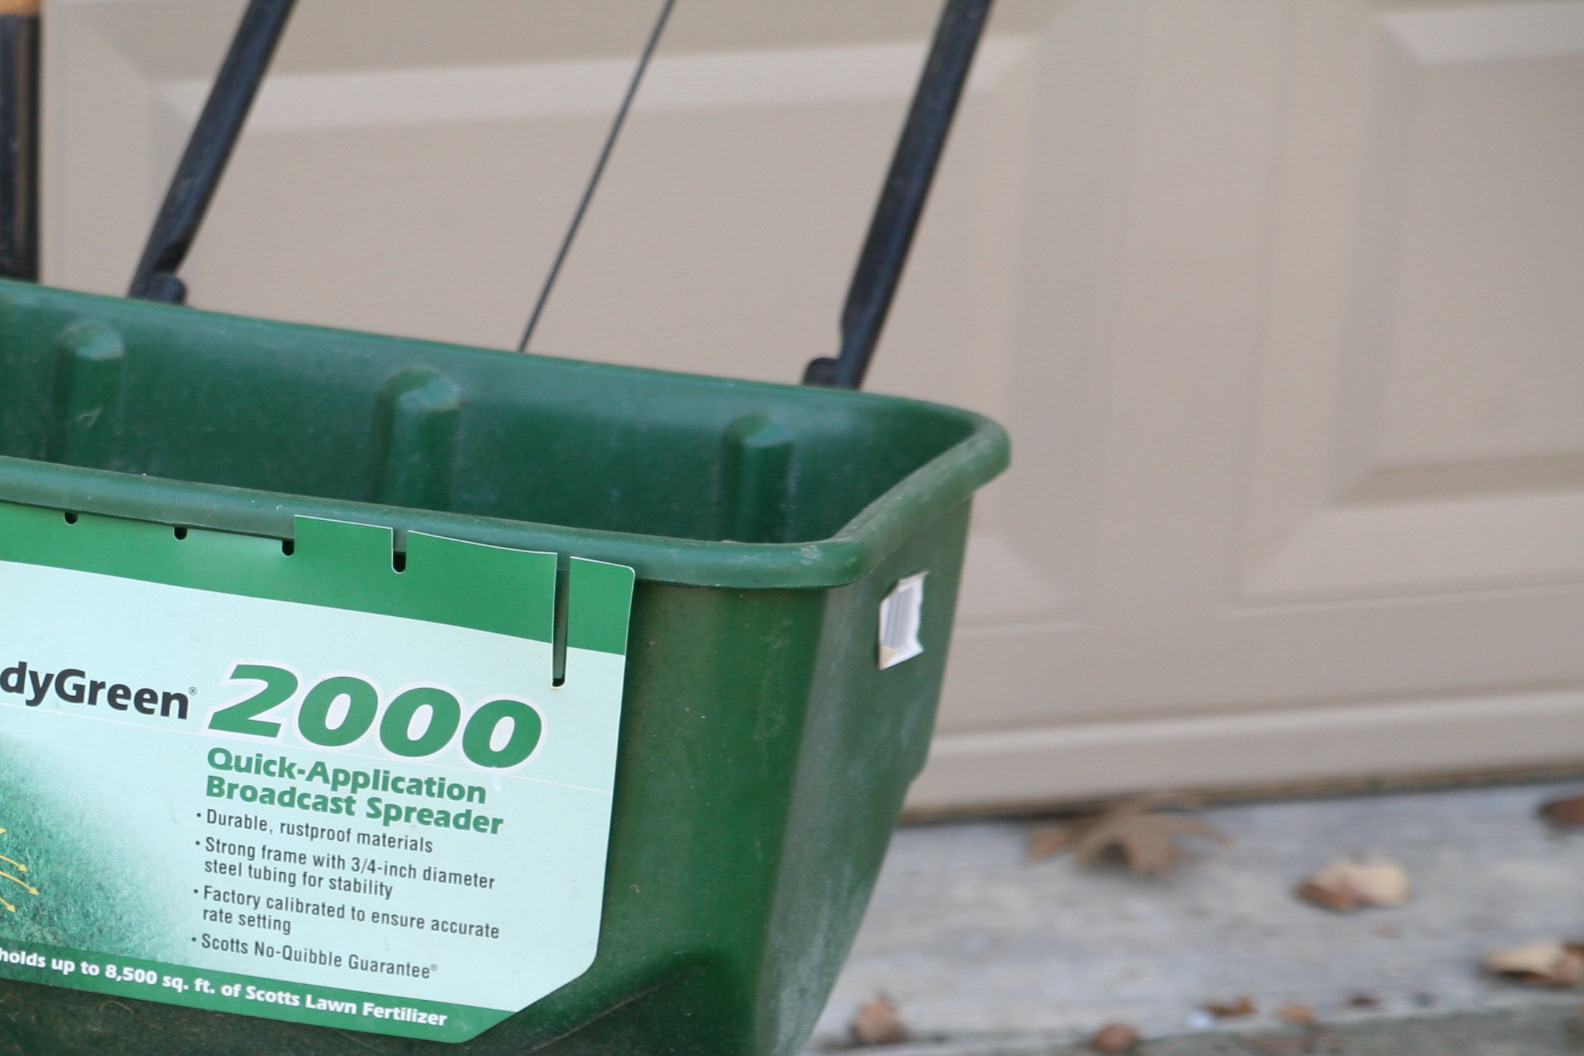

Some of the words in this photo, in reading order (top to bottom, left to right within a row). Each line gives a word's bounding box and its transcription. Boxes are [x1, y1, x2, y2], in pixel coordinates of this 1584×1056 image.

[207, 663, 542, 769] 2000
[207, 747, 486, 804] Quick-Application
[206, 775, 356, 816] Broadcast
[366, 797, 503, 834] Spreader
[207, 809, 273, 834] Durable,
[280, 821, 352, 843] rustproof
[357, 832, 433, 853] materials
[204, 860, 243, 877] steel
[248, 865, 297, 887] tubing
[302, 871, 324, 888] for
[329, 875, 393, 900] stability
[205, 837, 256, 861] Strong
[262, 845, 307, 865] frame
[313, 853, 346, 871] with
[351, 857, 417, 880] 3/4-inch
[423, 867, 495, 889] diameter
[203, 907, 233, 925] rate
[238, 912, 291, 935] setting
[204, 885, 261, 910] Factory
[266, 894, 345, 919] calibrated
[351, 906, 366, 922] to
[371, 911, 425, 930] ensure
[431, 918, 500, 939] accurate
[201, 933, 249, 954] Scotts
[254, 940, 343, 968] No-Quibble
[51, 959, 76, 975] up
[80, 961, 100, 977] to
[105, 964, 158, 985] 8,500
[162, 975, 189, 993] sq.
[194, 978, 215, 994] ft.
[221, 984, 241, 998] of
[245, 985, 300, 1007] Scotts
[305, 994, 357, 1015] Lawn
[362, 1002, 448, 1026] Fertilizer
